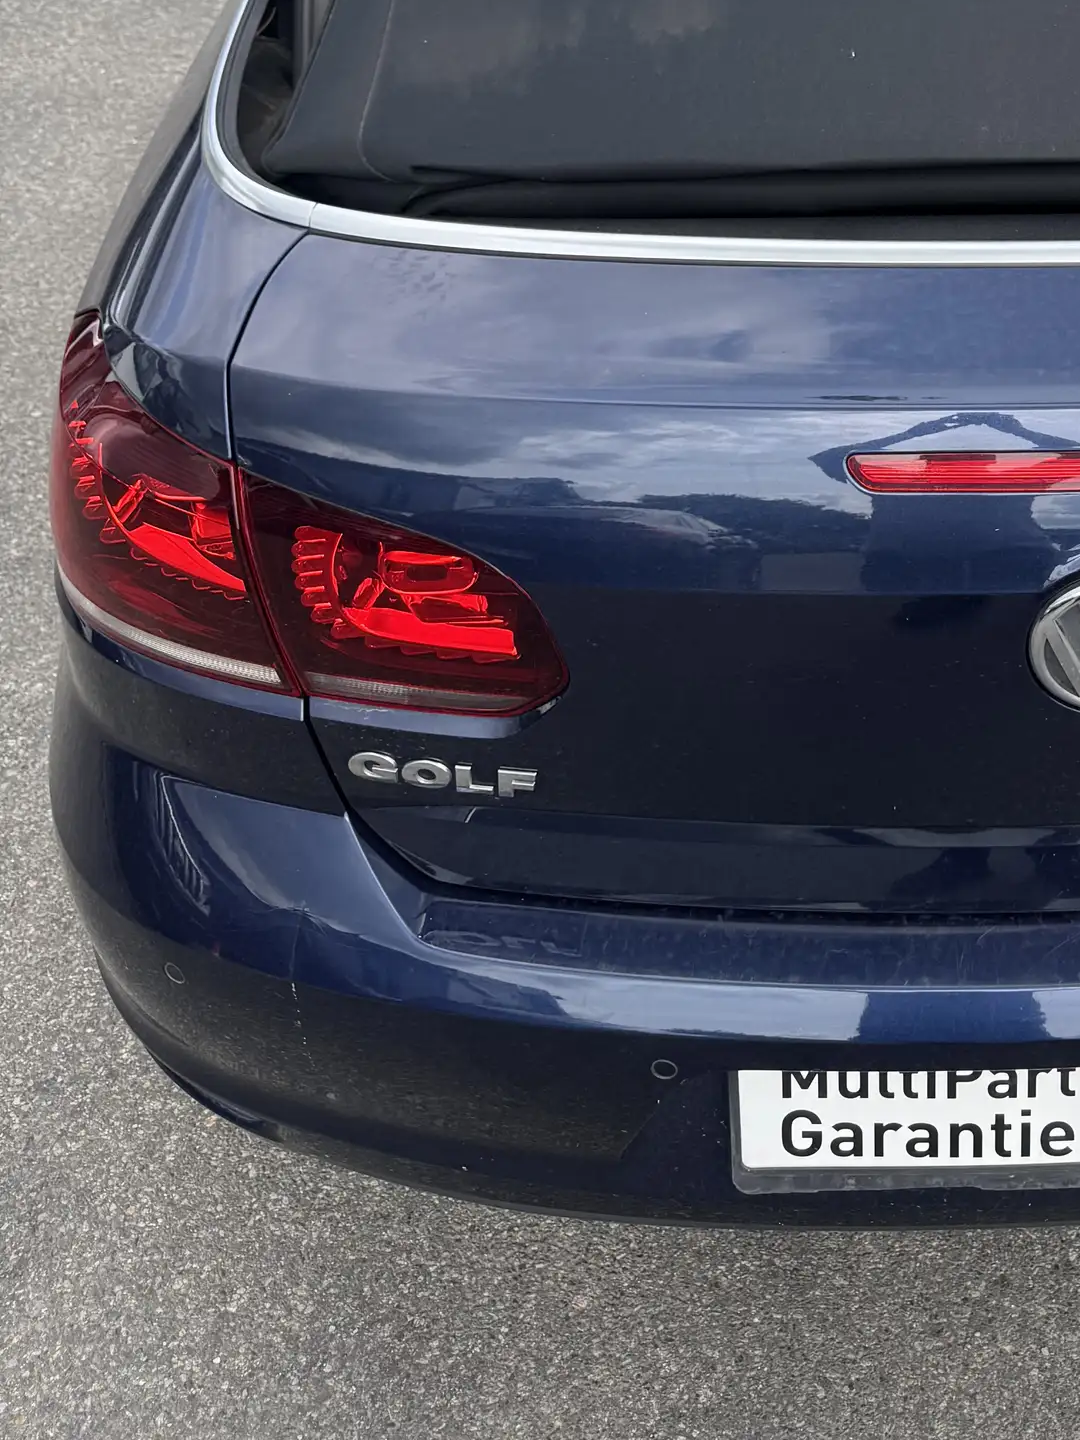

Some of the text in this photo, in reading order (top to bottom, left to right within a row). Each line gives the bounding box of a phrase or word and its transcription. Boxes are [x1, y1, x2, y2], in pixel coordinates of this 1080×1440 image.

[347, 750, 538, 798] GOLF
[781, 1068, 1076, 1099] MultiPart
[781, 1109, 1076, 1158] Garantie
